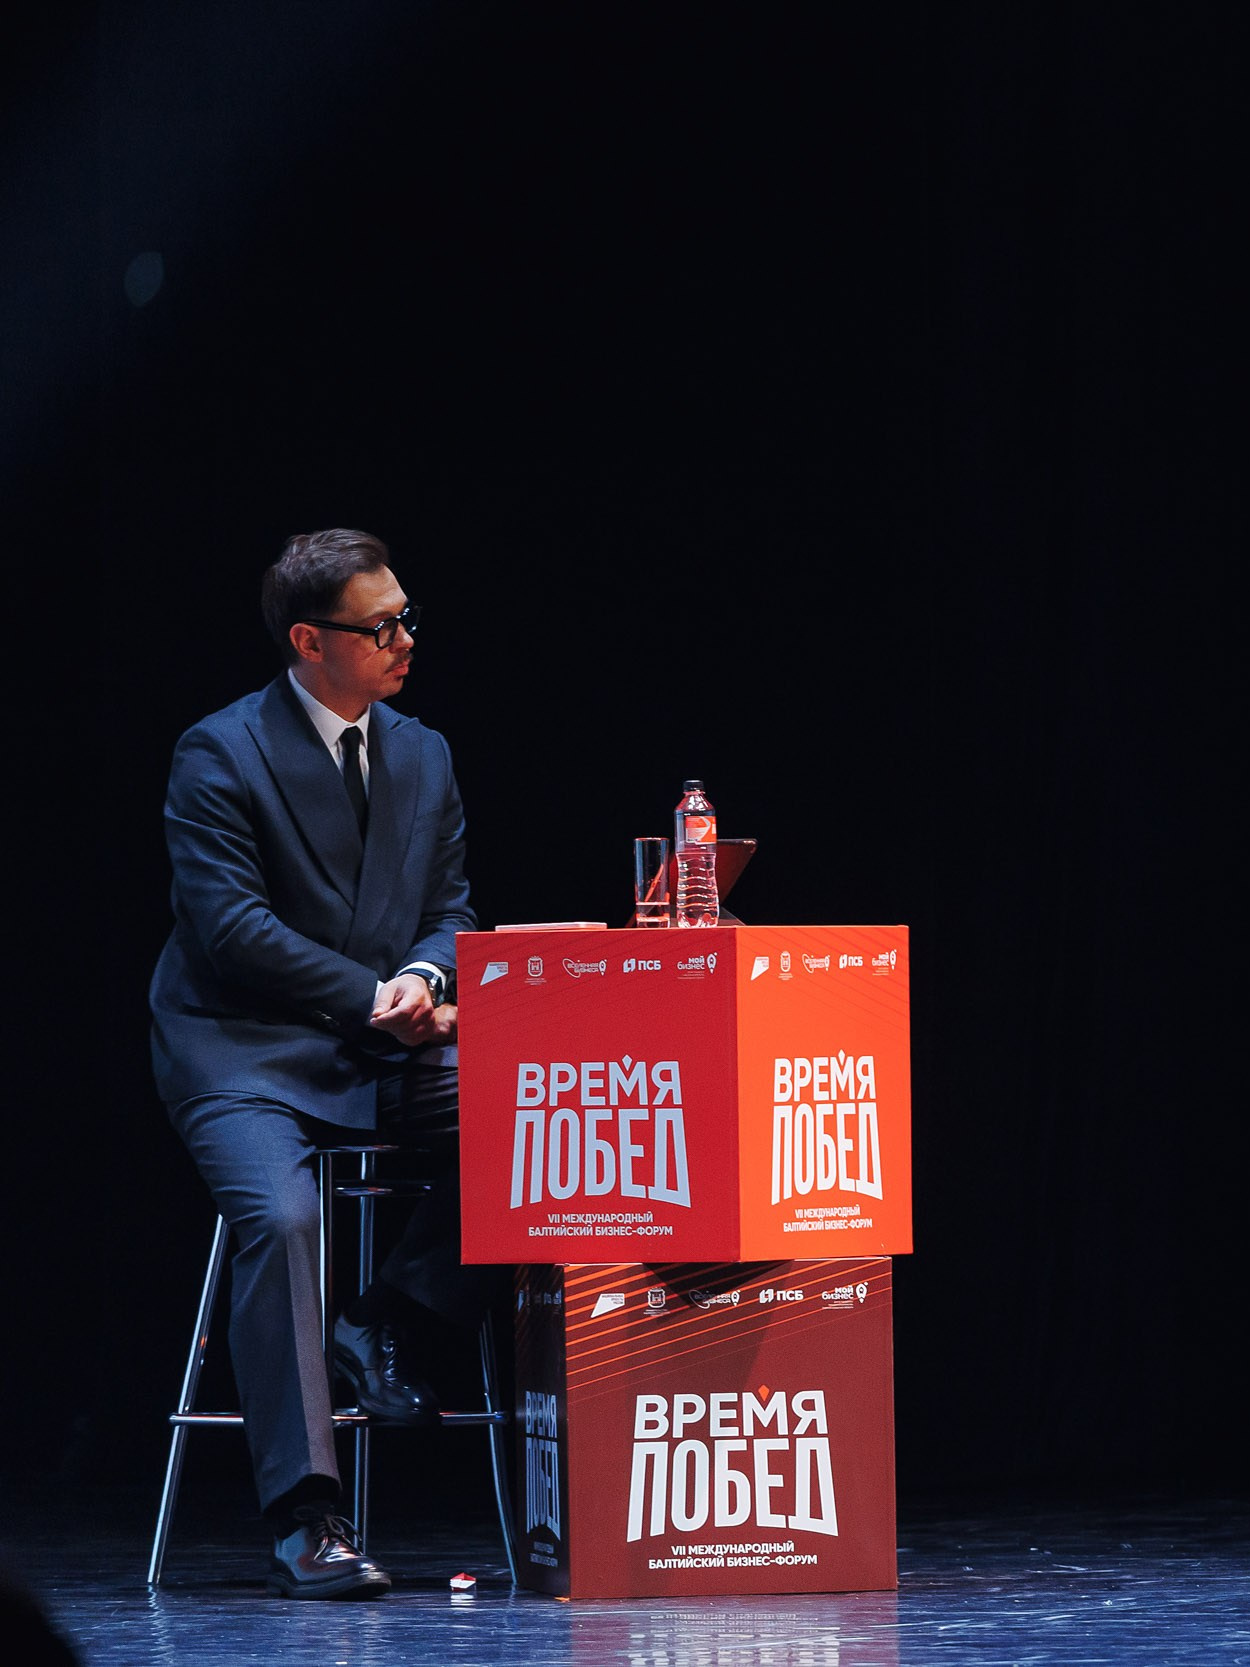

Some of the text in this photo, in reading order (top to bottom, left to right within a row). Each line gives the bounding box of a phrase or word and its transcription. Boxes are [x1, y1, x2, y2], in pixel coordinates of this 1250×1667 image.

[638, 960, 661, 970] ПСБ
[848, 956, 863, 967] ПСБ
[516, 1055, 683, 1107] ВРЕМЯ
[774, 1050, 876, 1102] ВРЕМЯ
[510, 1108, 691, 1209] ПОБЕД
[771, 1102, 883, 1206] ПОБЕД
[548, 1211, 653, 1224] VII МЕЖДУНАРОДНЫЙ
[795, 1205, 861, 1218] VII МЕЖДУНАРОДНЫЙ
[528, 1225, 673, 1237] БАЛТИЙСКИЙ БИЗНЕС-ФОРУМ
[783, 1218, 873, 1232] БАЛТИЙСКИЙ БИЗНЕС-ФОРУМ
[777, 1290, 804, 1301] ПСБ
[822, 1291, 854, 1300] бизнес
[634, 1385, 828, 1439] ВРЕМЯ
[627, 1437, 838, 1543] ПОБЕД
[671, 1541, 795, 1556] VII МЕЖДУНАРОДНЫЙ
[648, 1554, 818, 1569] БАЛТИЙСКИЙ БИЗНЕС-ФОРУМ
